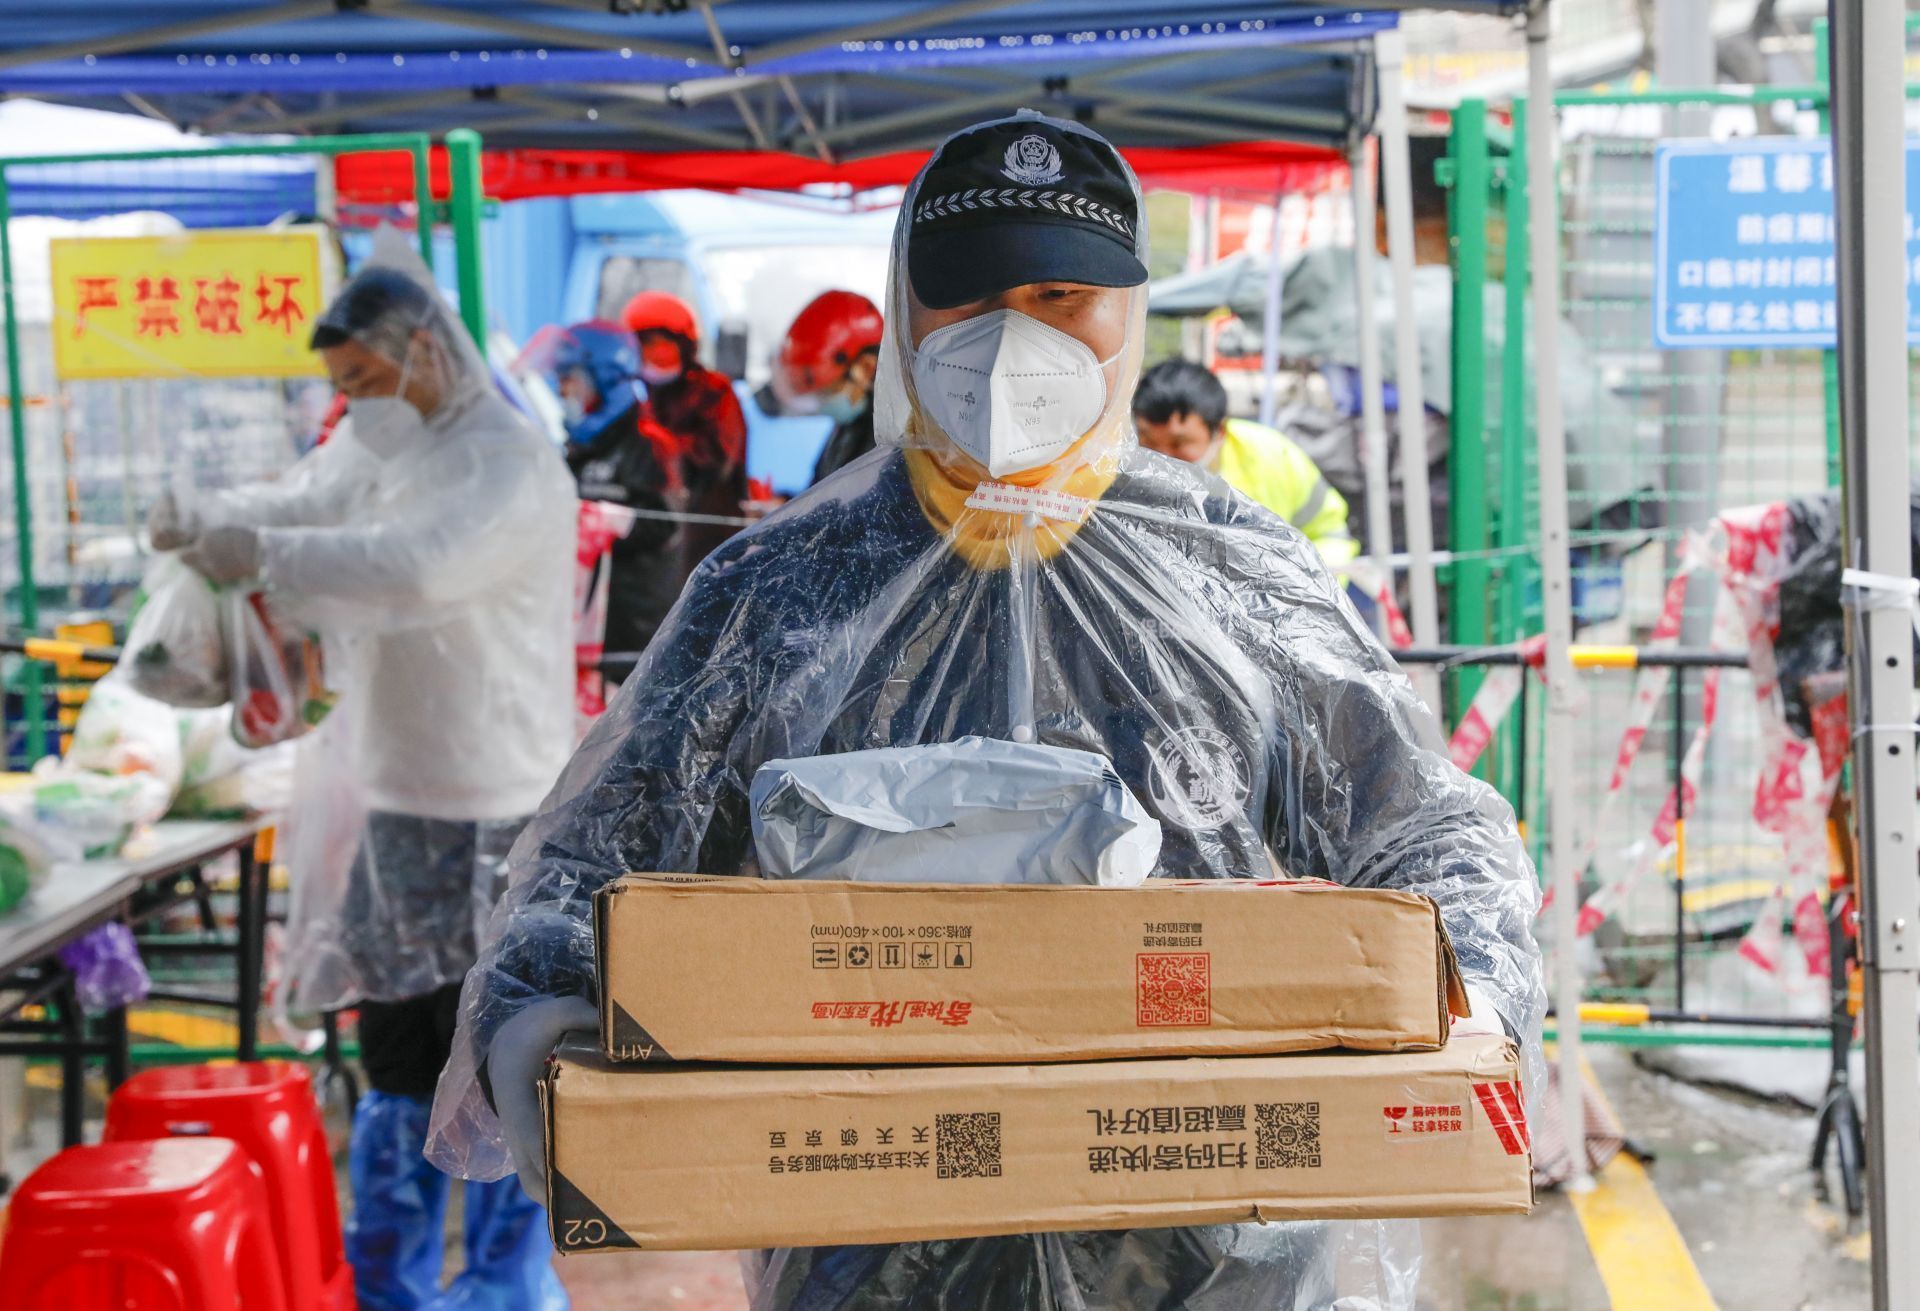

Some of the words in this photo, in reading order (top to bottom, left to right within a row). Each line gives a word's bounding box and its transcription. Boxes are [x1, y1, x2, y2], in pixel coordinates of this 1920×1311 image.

[1728, 153, 1833, 193] 温馨
[1737, 213, 1834, 245] 防疫期
[73, 276, 305, 337] 严禁破坏
[1024, 416, 1041, 427] N95
[1143, 936, 1203, 947] 扫码寄快递
[621, 1044, 654, 1060] A11
[1086, 1104, 1247, 1135] 赢超值好礼
[1412, 1105, 1462, 1117] 易碎物品
[1412, 1120, 1462, 1132] 轻拿轻放
[768, 1150, 930, 1174] 关注京东购物服务号
[1087, 1142, 1249, 1173] 扫码寄快递
[564, 1218, 607, 1246] C2
